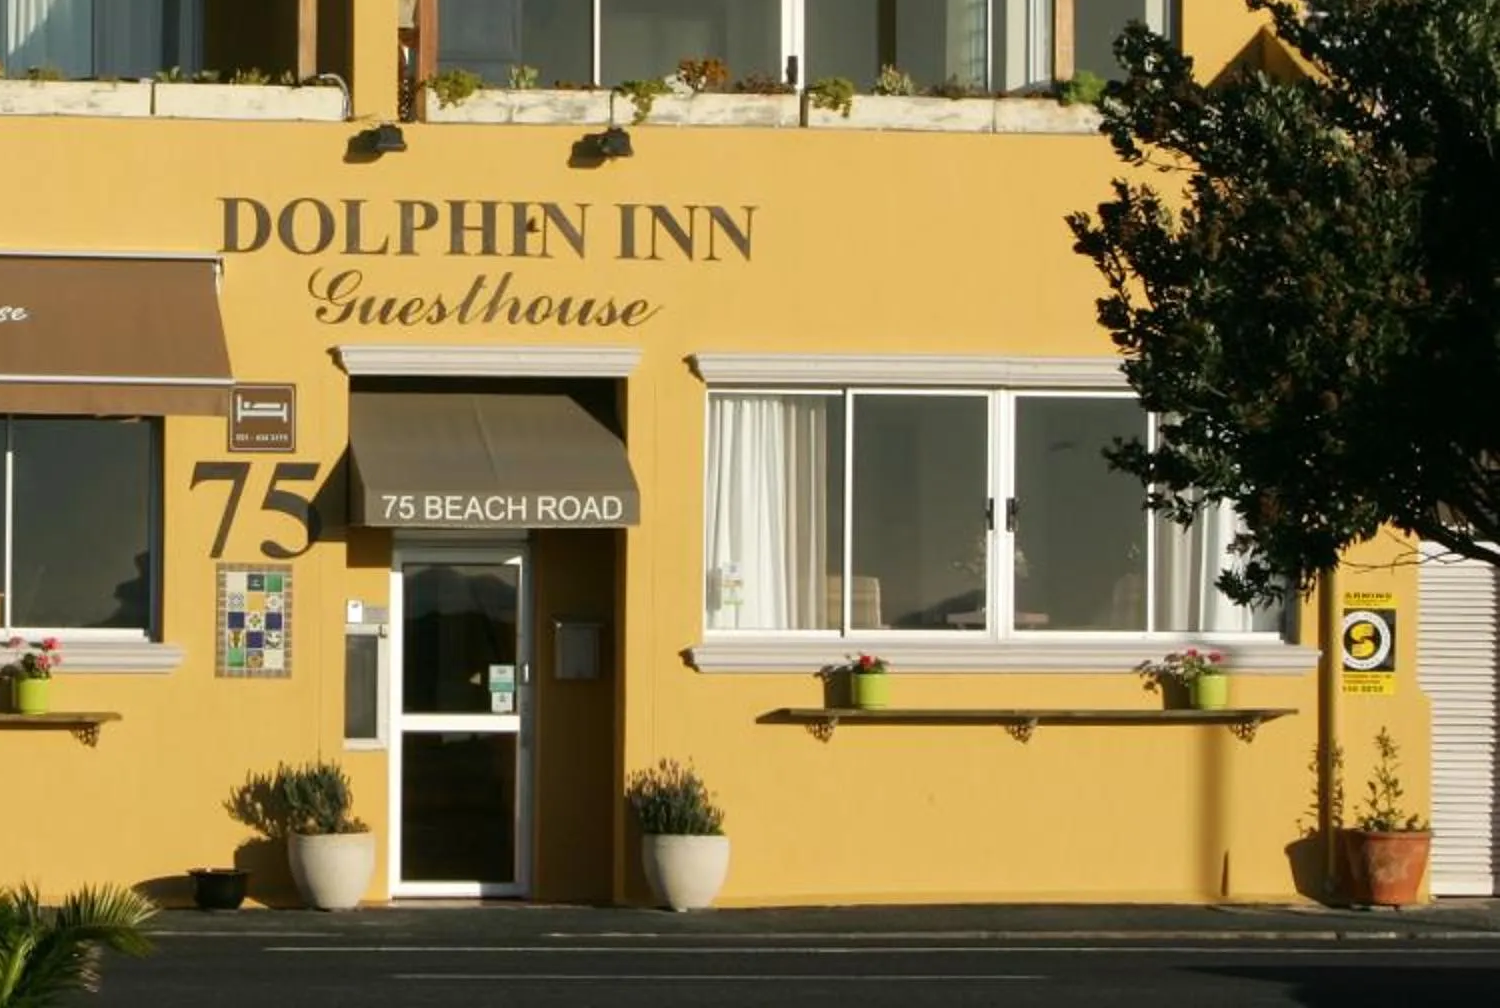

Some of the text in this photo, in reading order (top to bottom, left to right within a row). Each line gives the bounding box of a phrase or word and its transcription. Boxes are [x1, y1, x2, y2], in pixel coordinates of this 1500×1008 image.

[614, 203, 758, 262] INN
[307, 267, 662, 327] Guesthouse
[189, 461, 322, 559] 75
[381, 495, 622, 521] 75 BEACH ROAD
